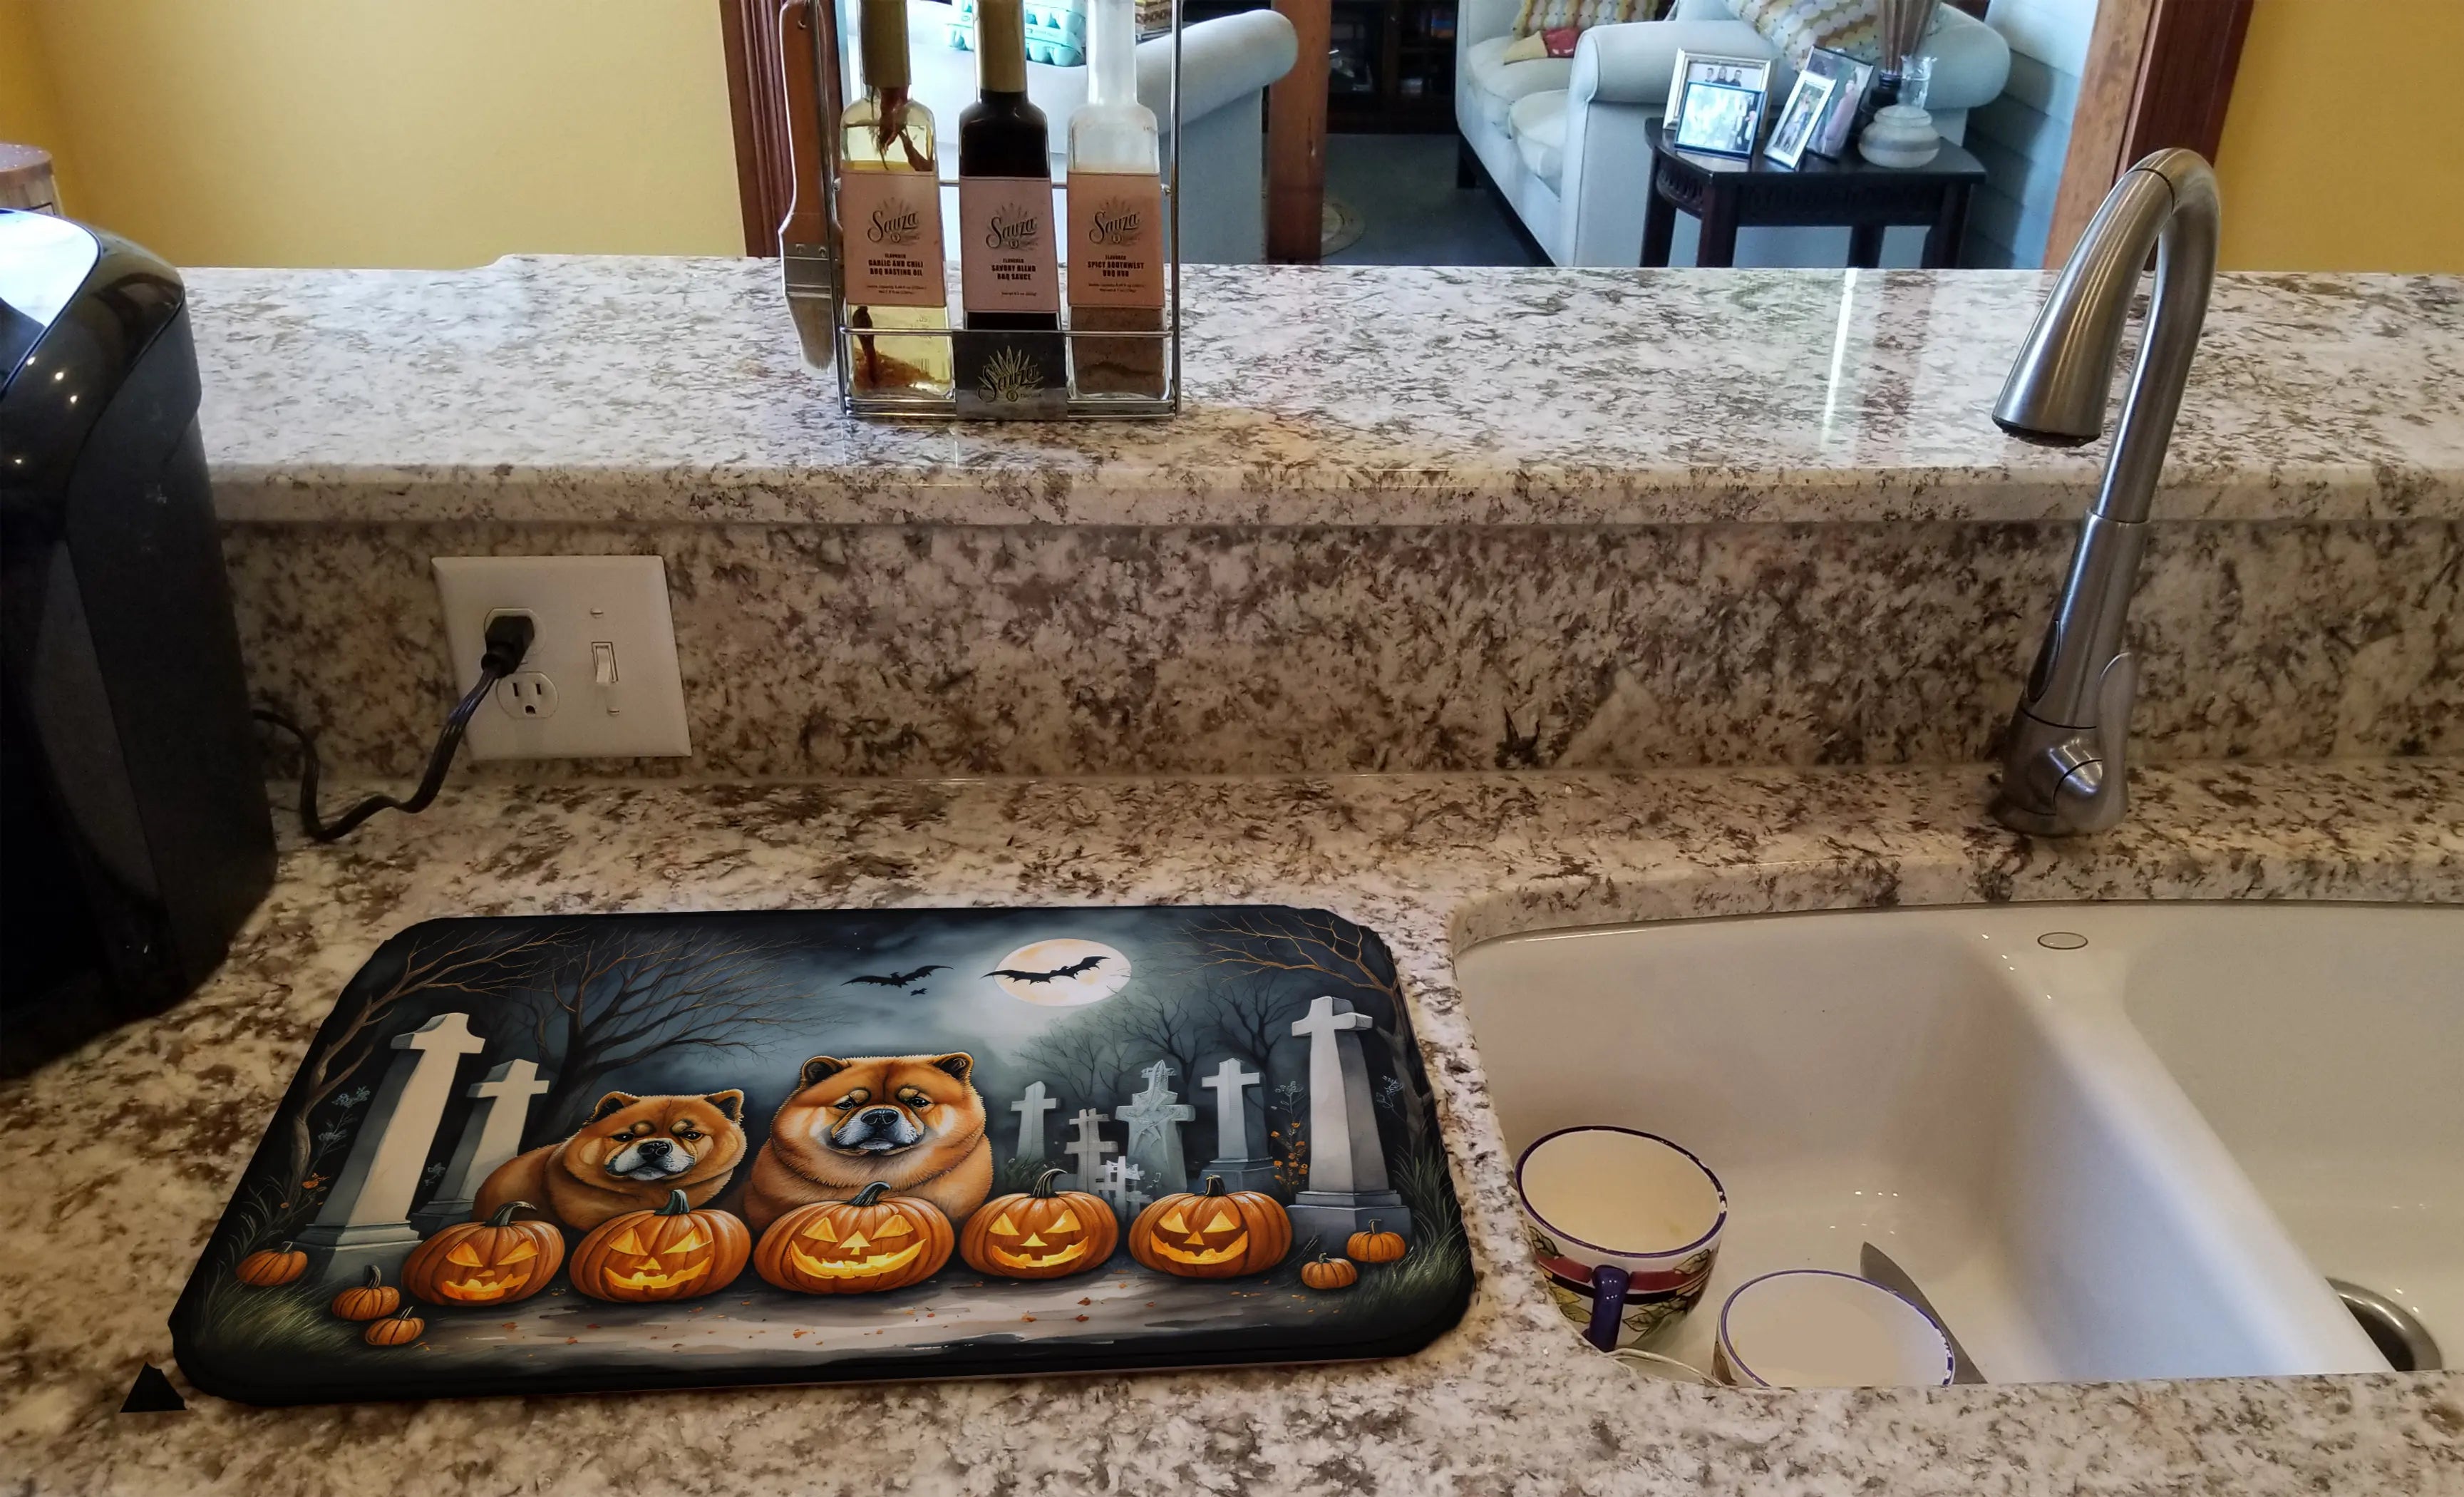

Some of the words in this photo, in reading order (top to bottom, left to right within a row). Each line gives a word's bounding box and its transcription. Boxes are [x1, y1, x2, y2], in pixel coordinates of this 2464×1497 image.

[867, 210, 919, 242] Sauza
[986, 216, 1037, 249] Sauza
[1089, 211, 1139, 245] Sauza
